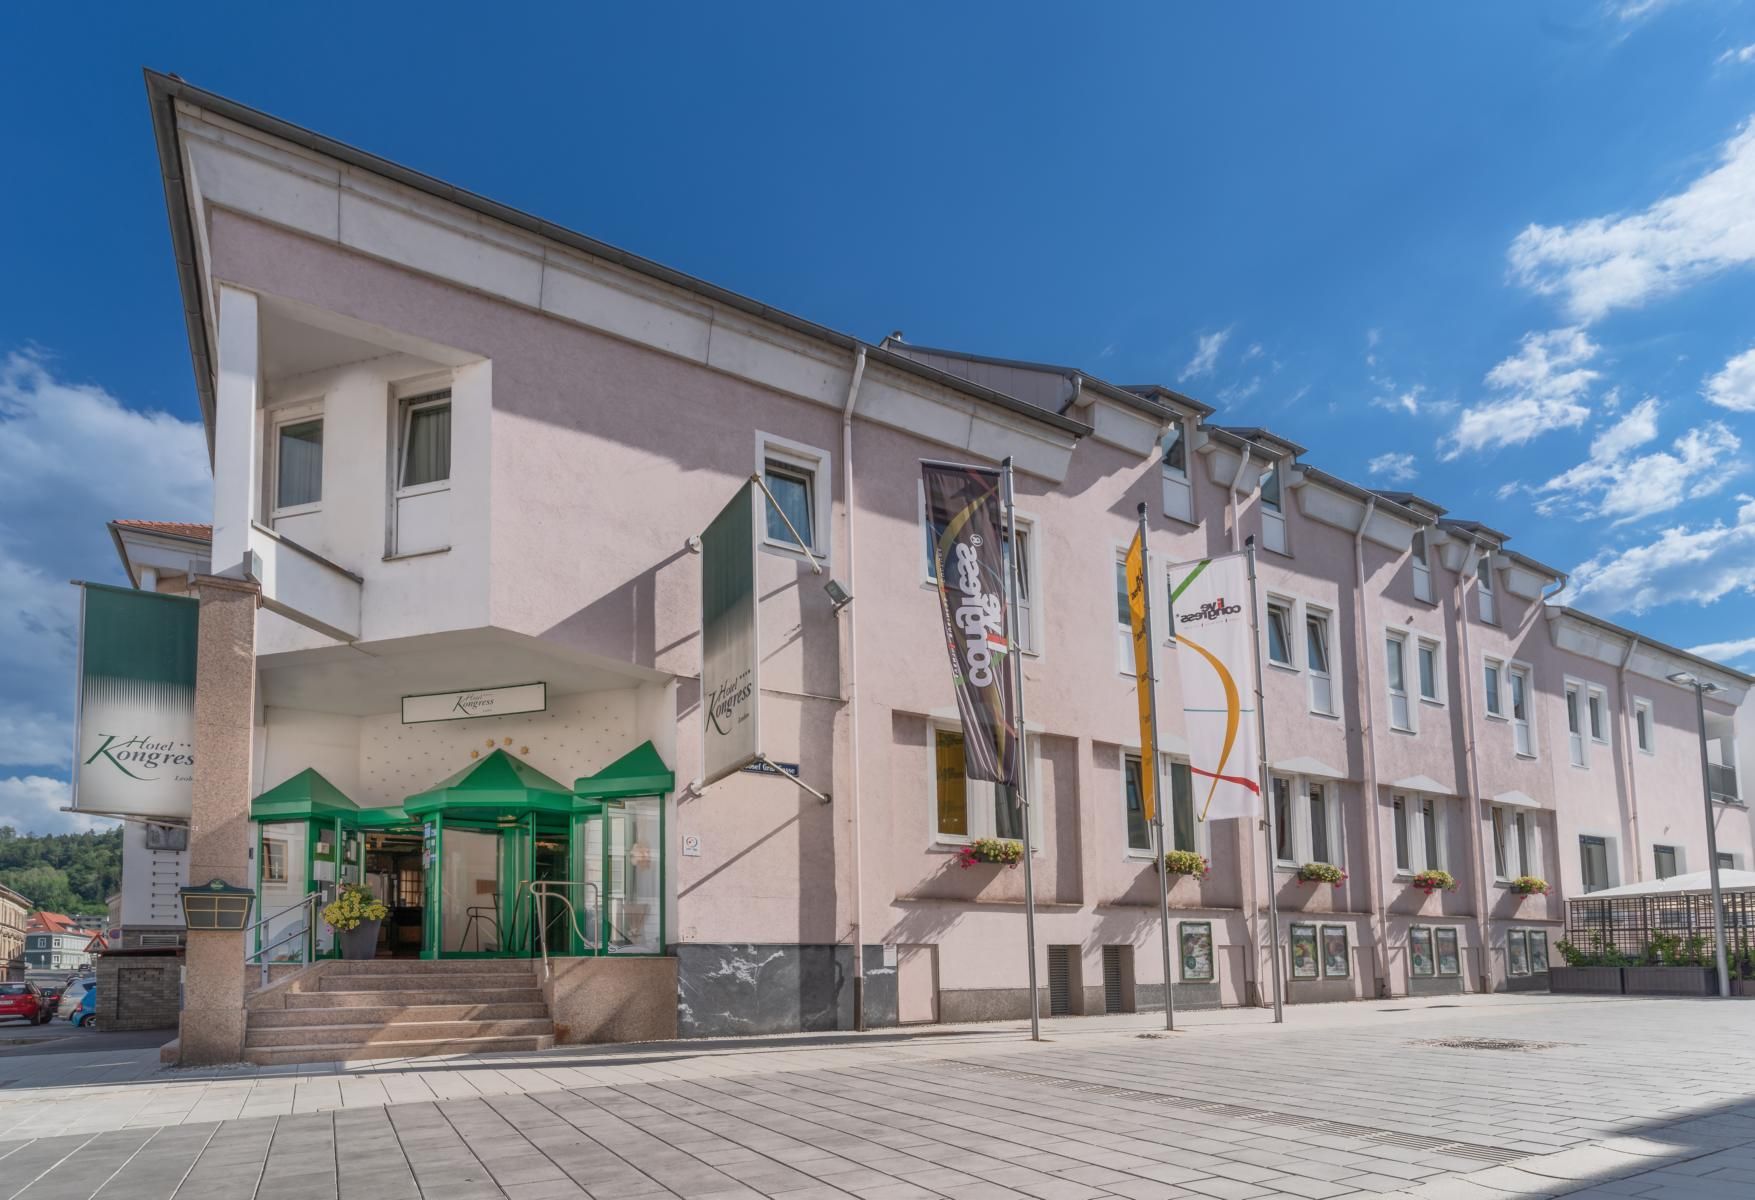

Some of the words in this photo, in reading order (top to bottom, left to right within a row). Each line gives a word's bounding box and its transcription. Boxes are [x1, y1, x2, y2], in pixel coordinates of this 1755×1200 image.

[718, 677, 738, 700] Hotel
[452, 696, 496, 715] Kongress
[705, 683, 752, 735] Kongress
[124, 736, 174, 752] Hotel
[84, 733, 194, 780] Kongres
